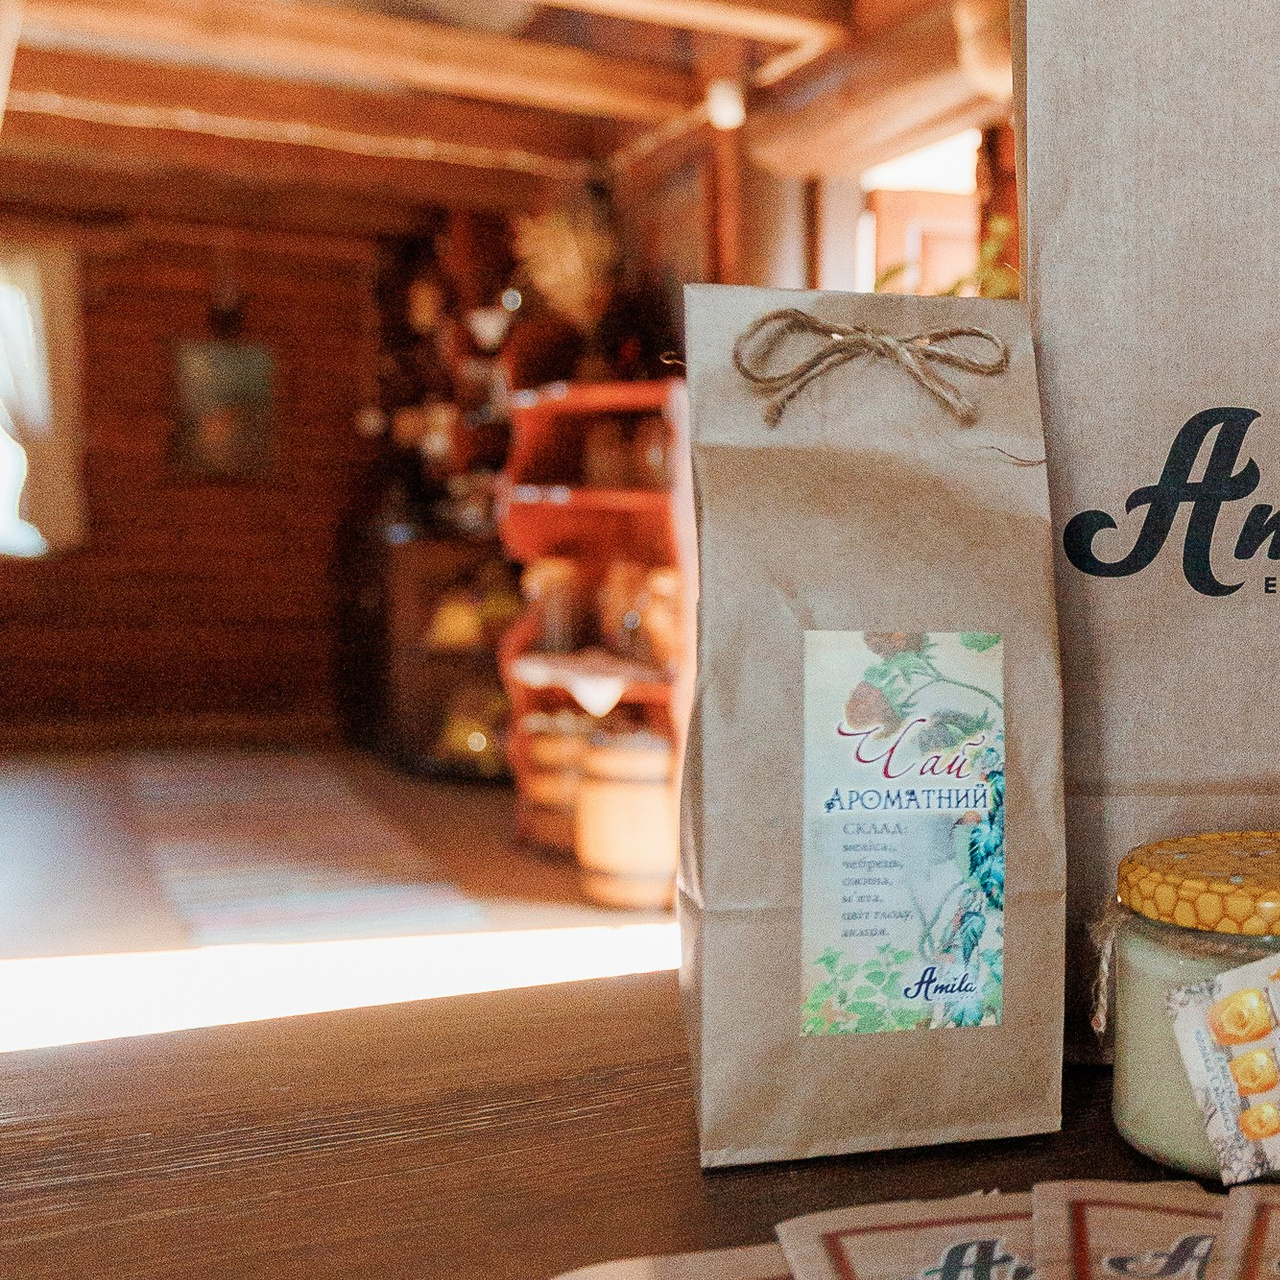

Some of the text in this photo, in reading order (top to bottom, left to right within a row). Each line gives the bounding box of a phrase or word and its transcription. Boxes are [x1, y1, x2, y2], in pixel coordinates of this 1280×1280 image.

[837, 718, 986, 779] Чай
[824, 783, 989, 813] АРОМАТНИЙ
[903, 966, 977, 1001] Amila
